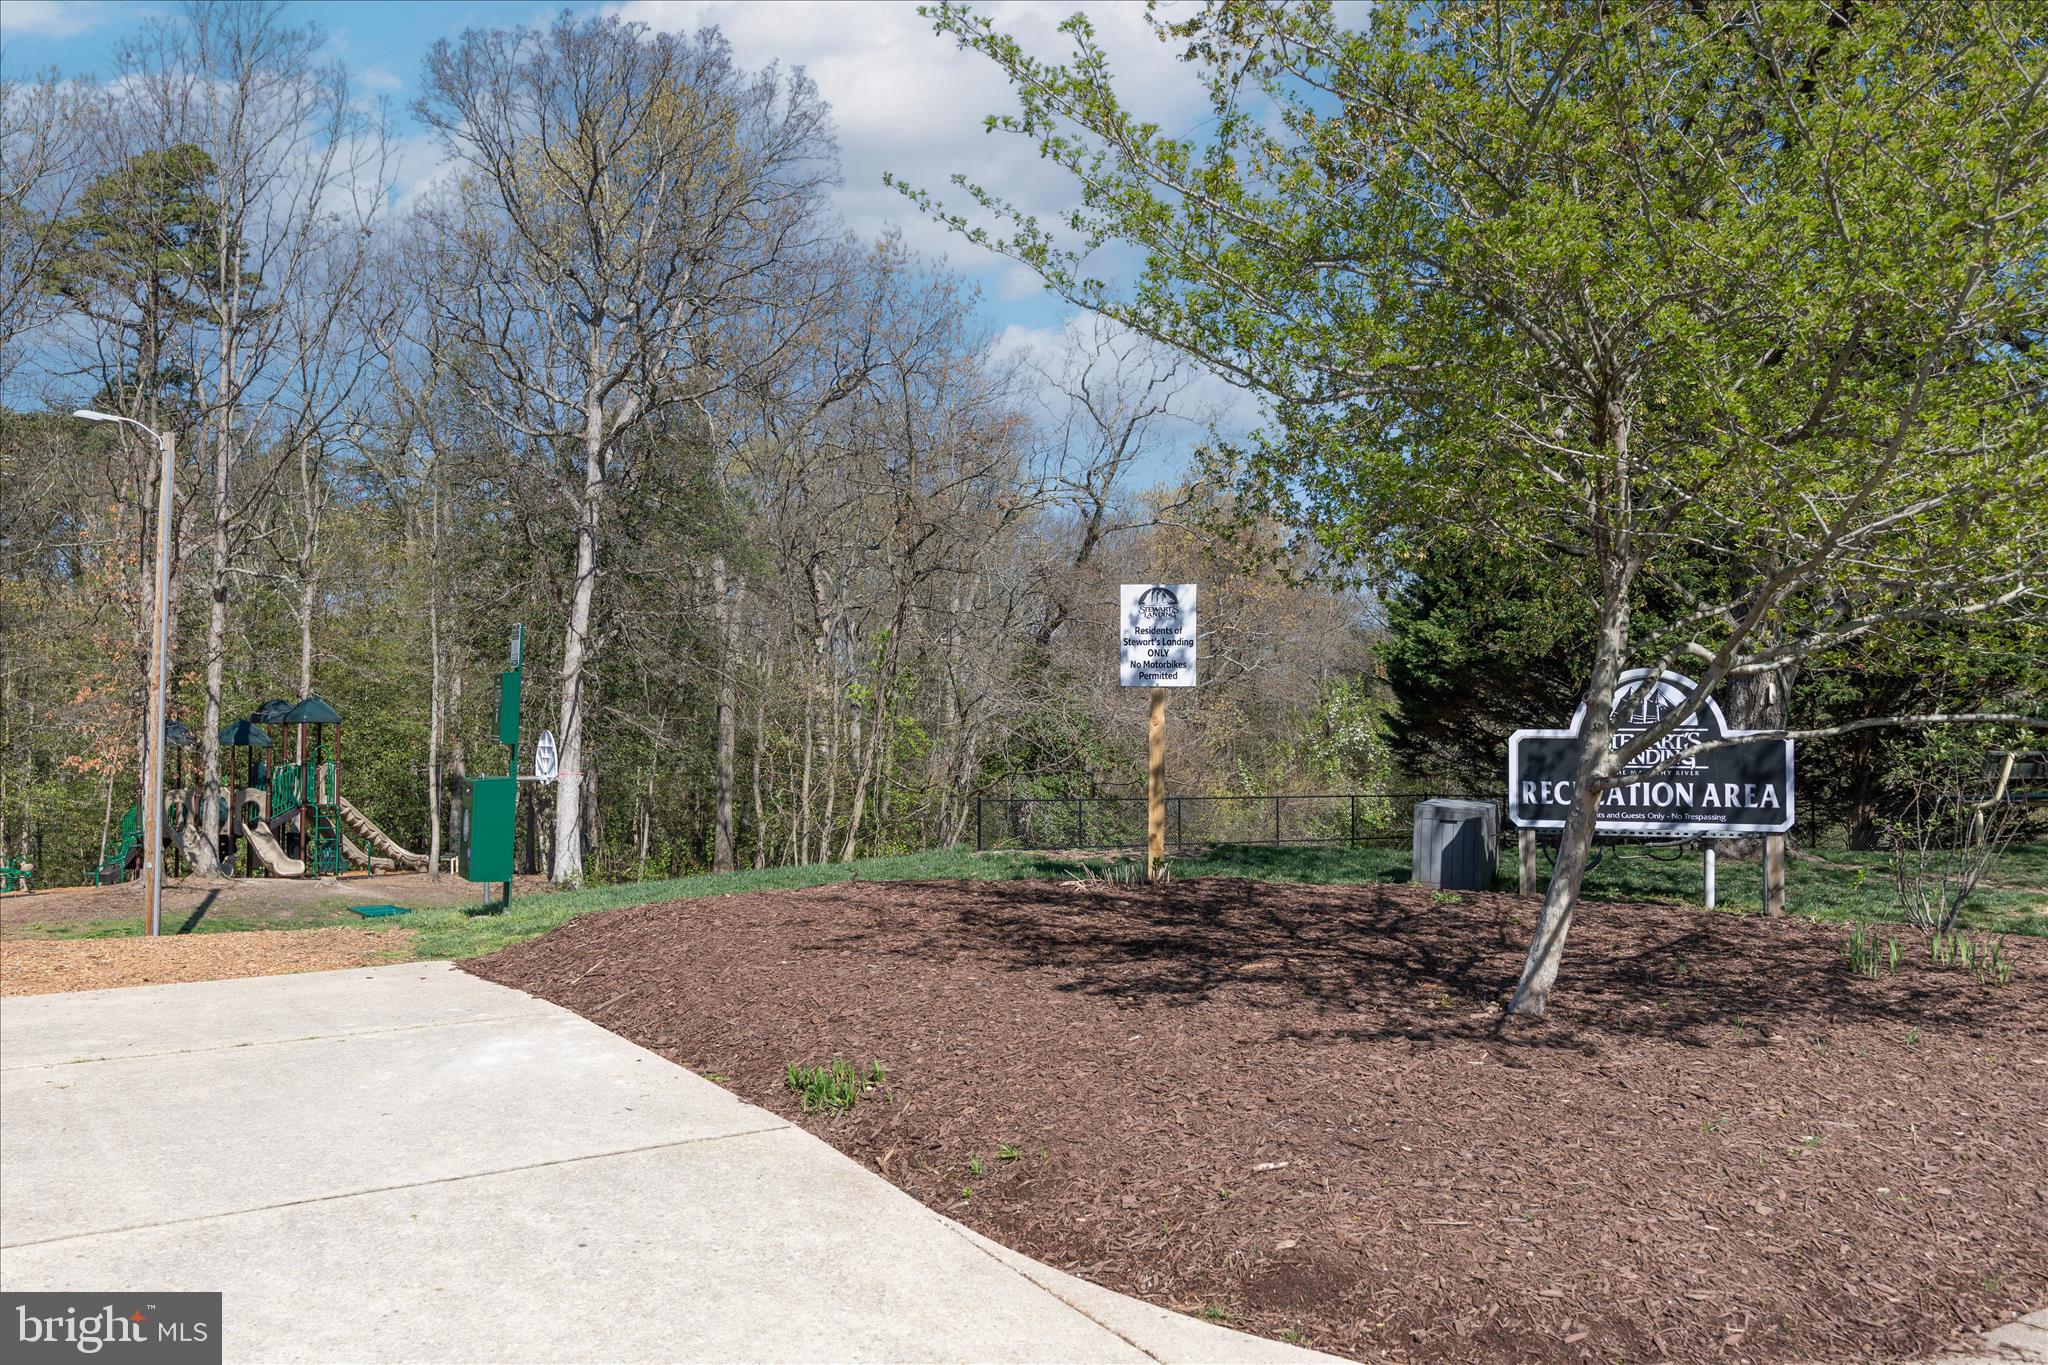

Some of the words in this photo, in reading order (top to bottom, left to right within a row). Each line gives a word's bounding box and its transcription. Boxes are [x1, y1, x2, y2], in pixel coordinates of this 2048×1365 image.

[1138, 606, 1179, 615] STEWART'S
[1144, 612, 1177, 620] LANDING
[1134, 626, 1173, 635] Residents
[1174, 626, 1183, 635] of
[1123, 638, 1161, 646] Stewart's
[1162, 638, 1194, 647] Landing
[1147, 649, 1170, 657] ONLY
[1130, 661, 1142, 669] No
[1143, 660, 1187, 669] Motorbikes
[1139, 671, 1178, 680] Permitted
[1522, 780, 1694, 807] RECATION
[1701, 783, 1780, 808] AREA
[1647, 813, 1666, 821] Only
[1684, 813, 1727, 822] Trespassing
